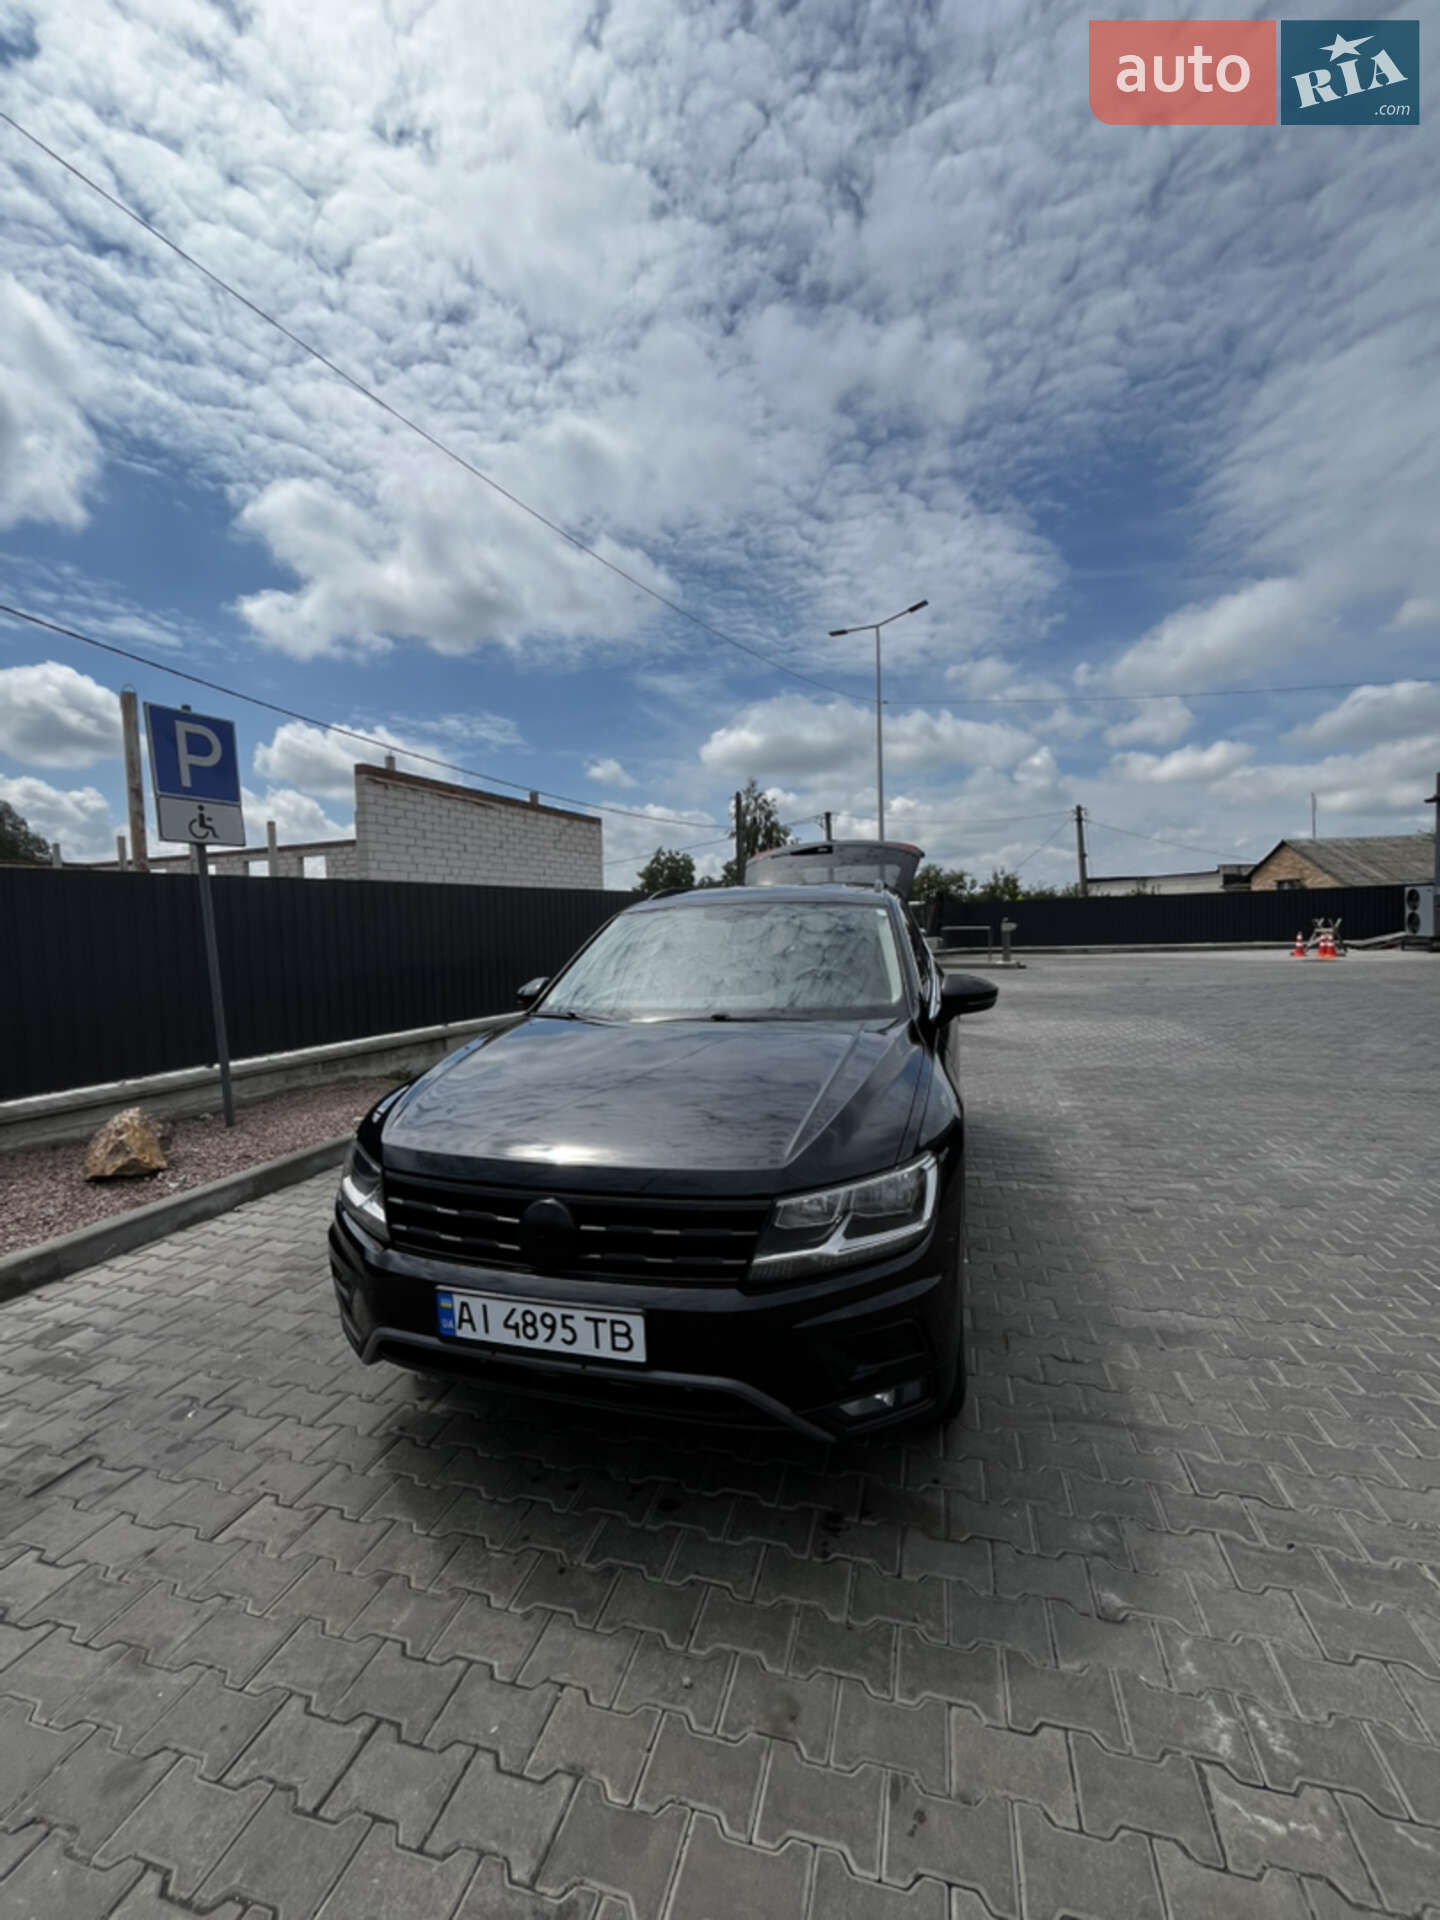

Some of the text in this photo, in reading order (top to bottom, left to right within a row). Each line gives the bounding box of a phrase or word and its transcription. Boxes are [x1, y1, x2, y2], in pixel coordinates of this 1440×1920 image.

[175, 720, 222, 788] P
[457, 1301, 634, 1352] AI 4895 TB
